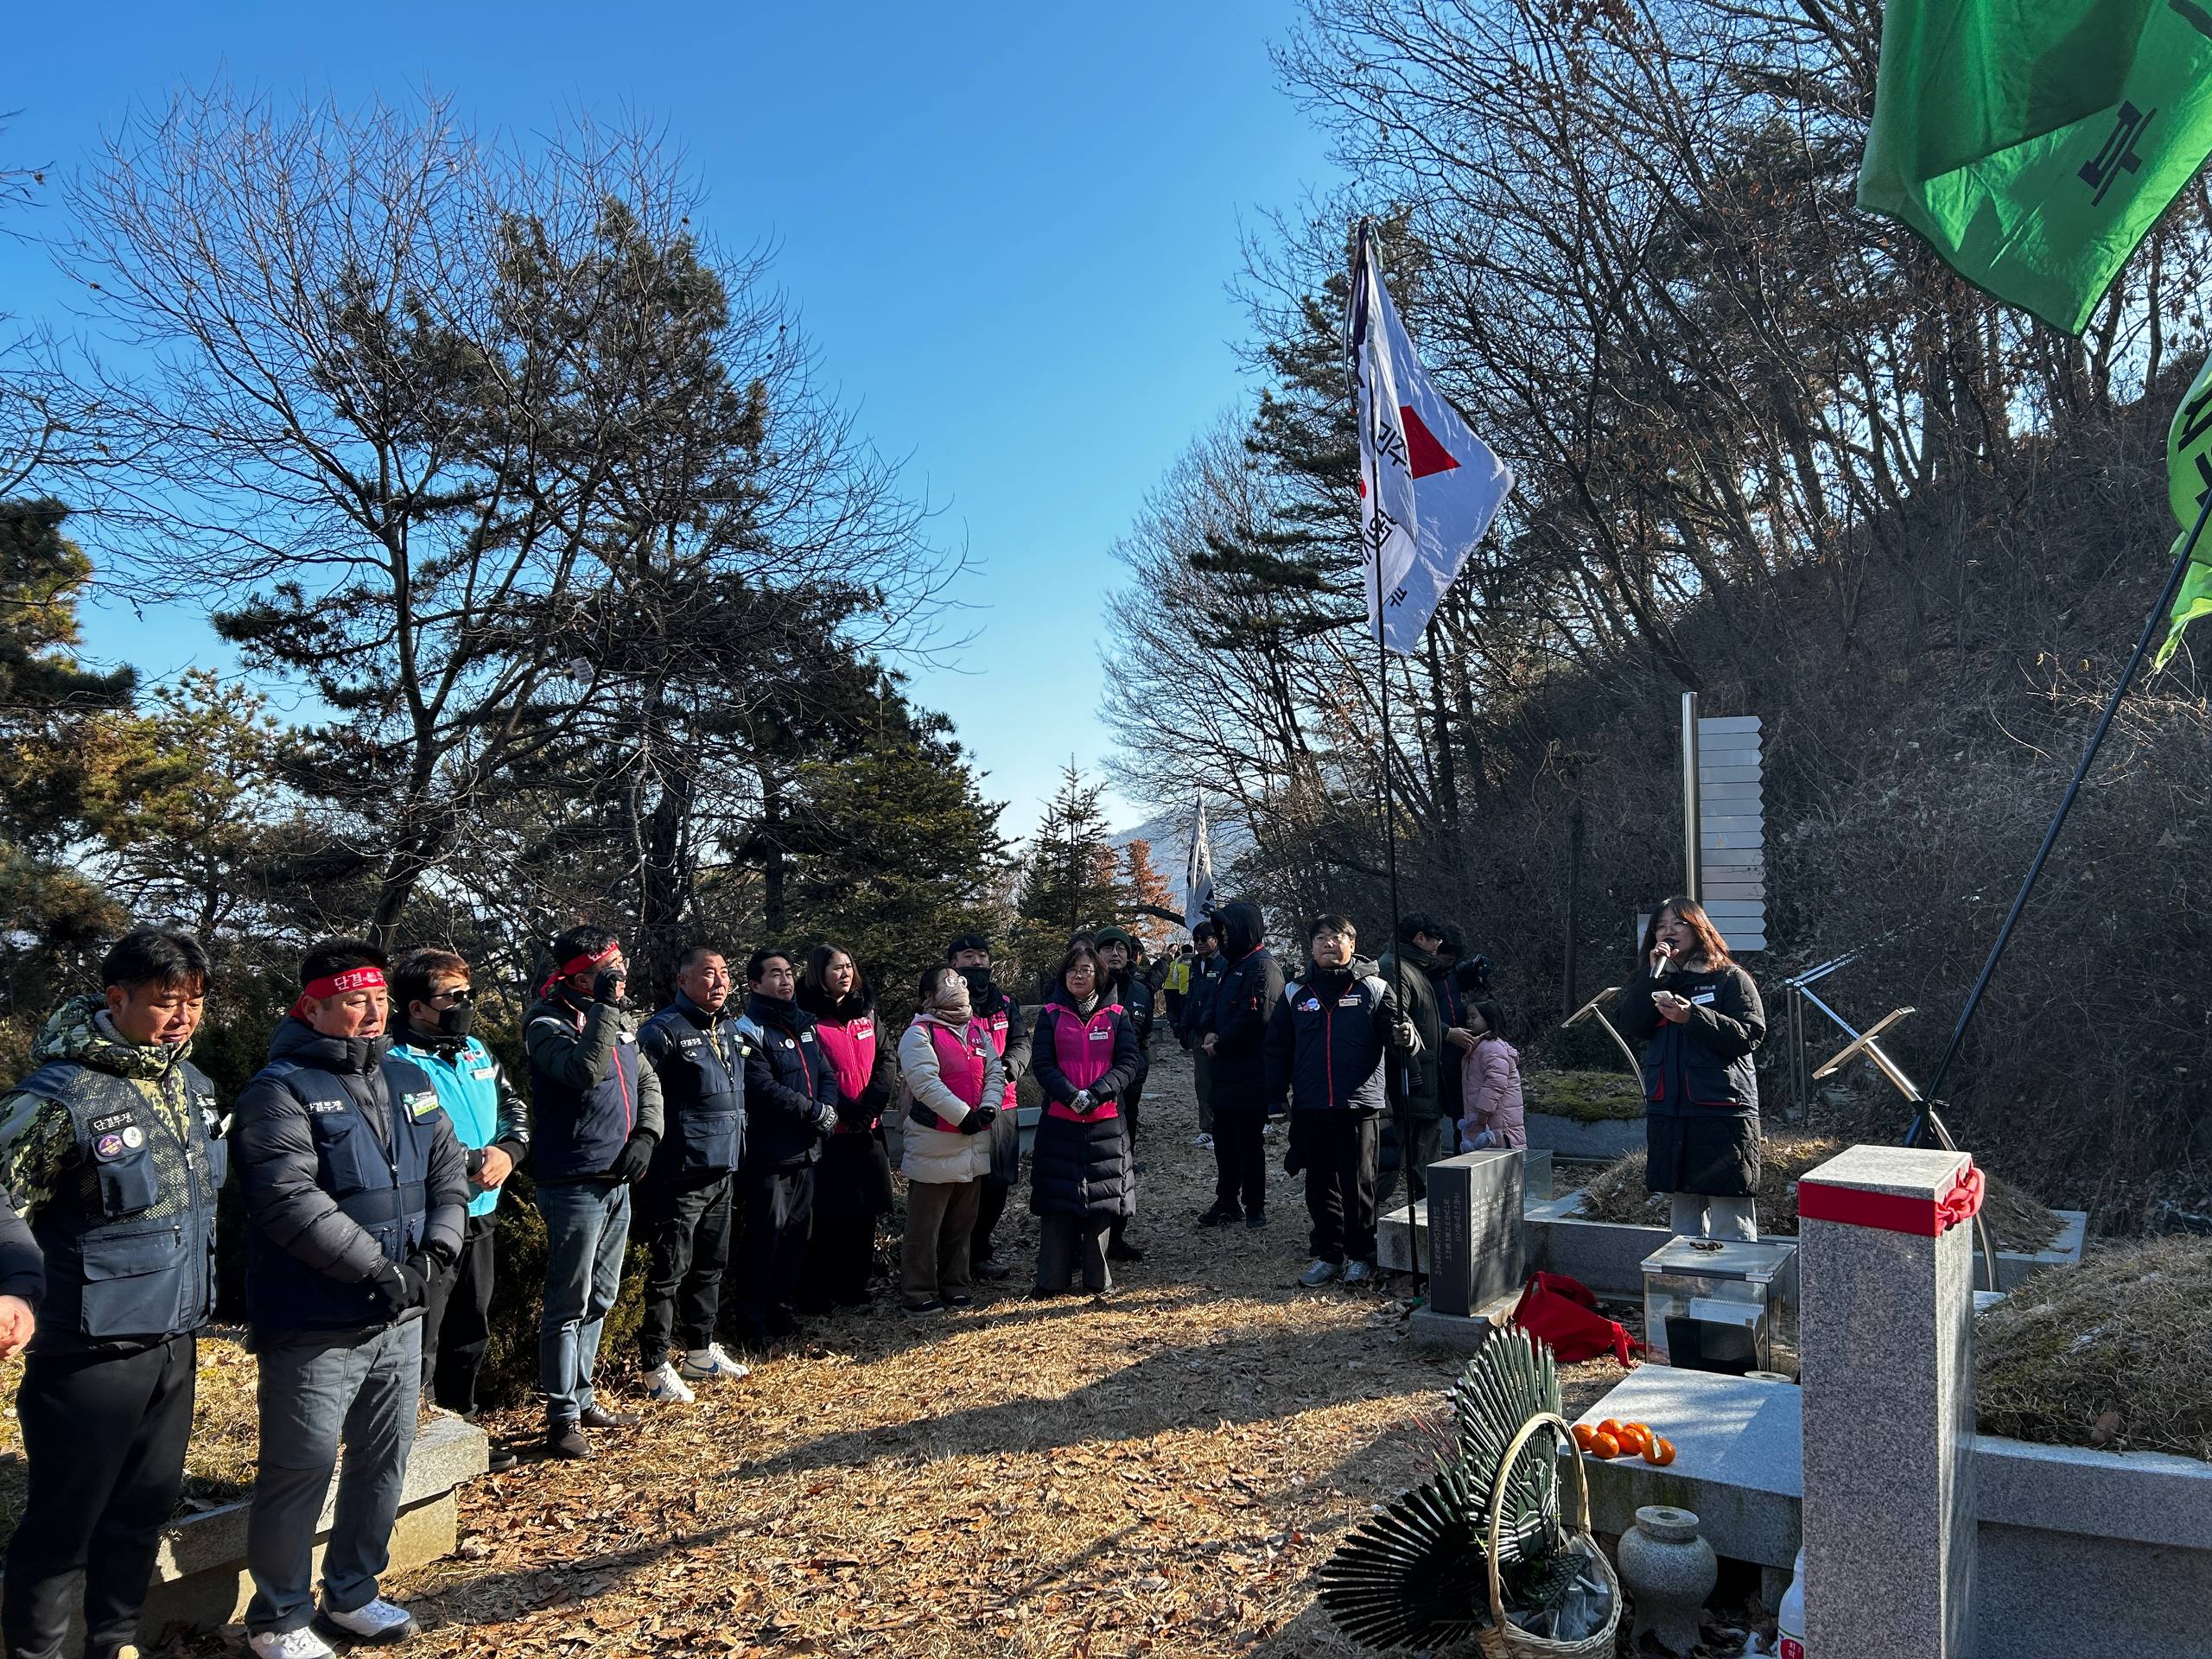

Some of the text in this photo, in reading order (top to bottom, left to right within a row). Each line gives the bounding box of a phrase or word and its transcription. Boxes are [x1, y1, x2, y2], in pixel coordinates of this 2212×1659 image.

[334, 971, 364, 991] 단결
[303, 1100, 344, 1115] 단결투쟁
[92, 1111, 133, 1131] 단결투쟁
